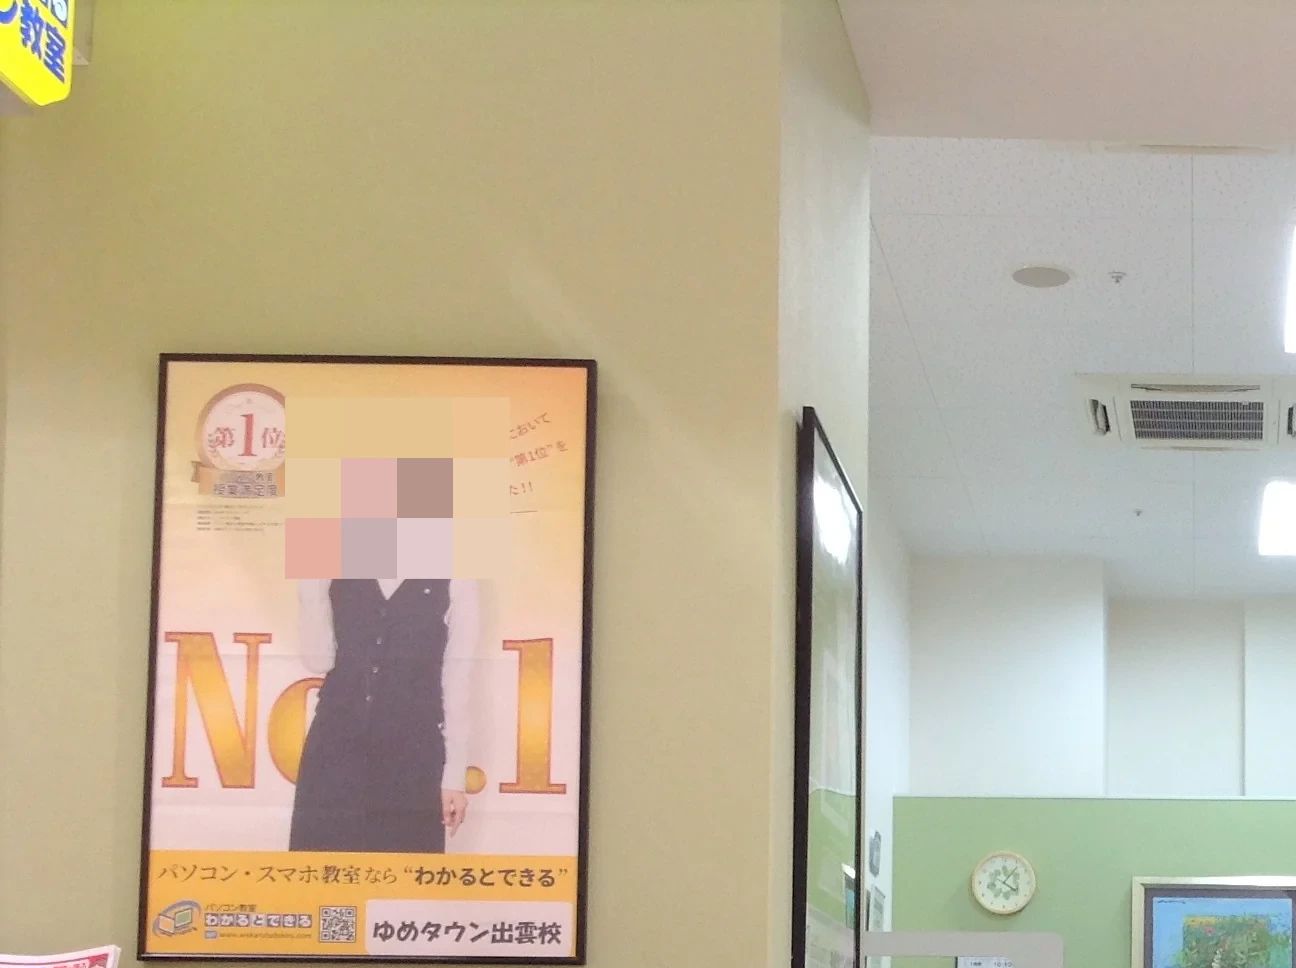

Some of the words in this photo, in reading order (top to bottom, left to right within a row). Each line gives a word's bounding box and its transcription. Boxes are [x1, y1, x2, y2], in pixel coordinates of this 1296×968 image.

[204, 913, 313, 929] わかるとできる
[373, 920, 562, 945] ゆめタウン出雲校
